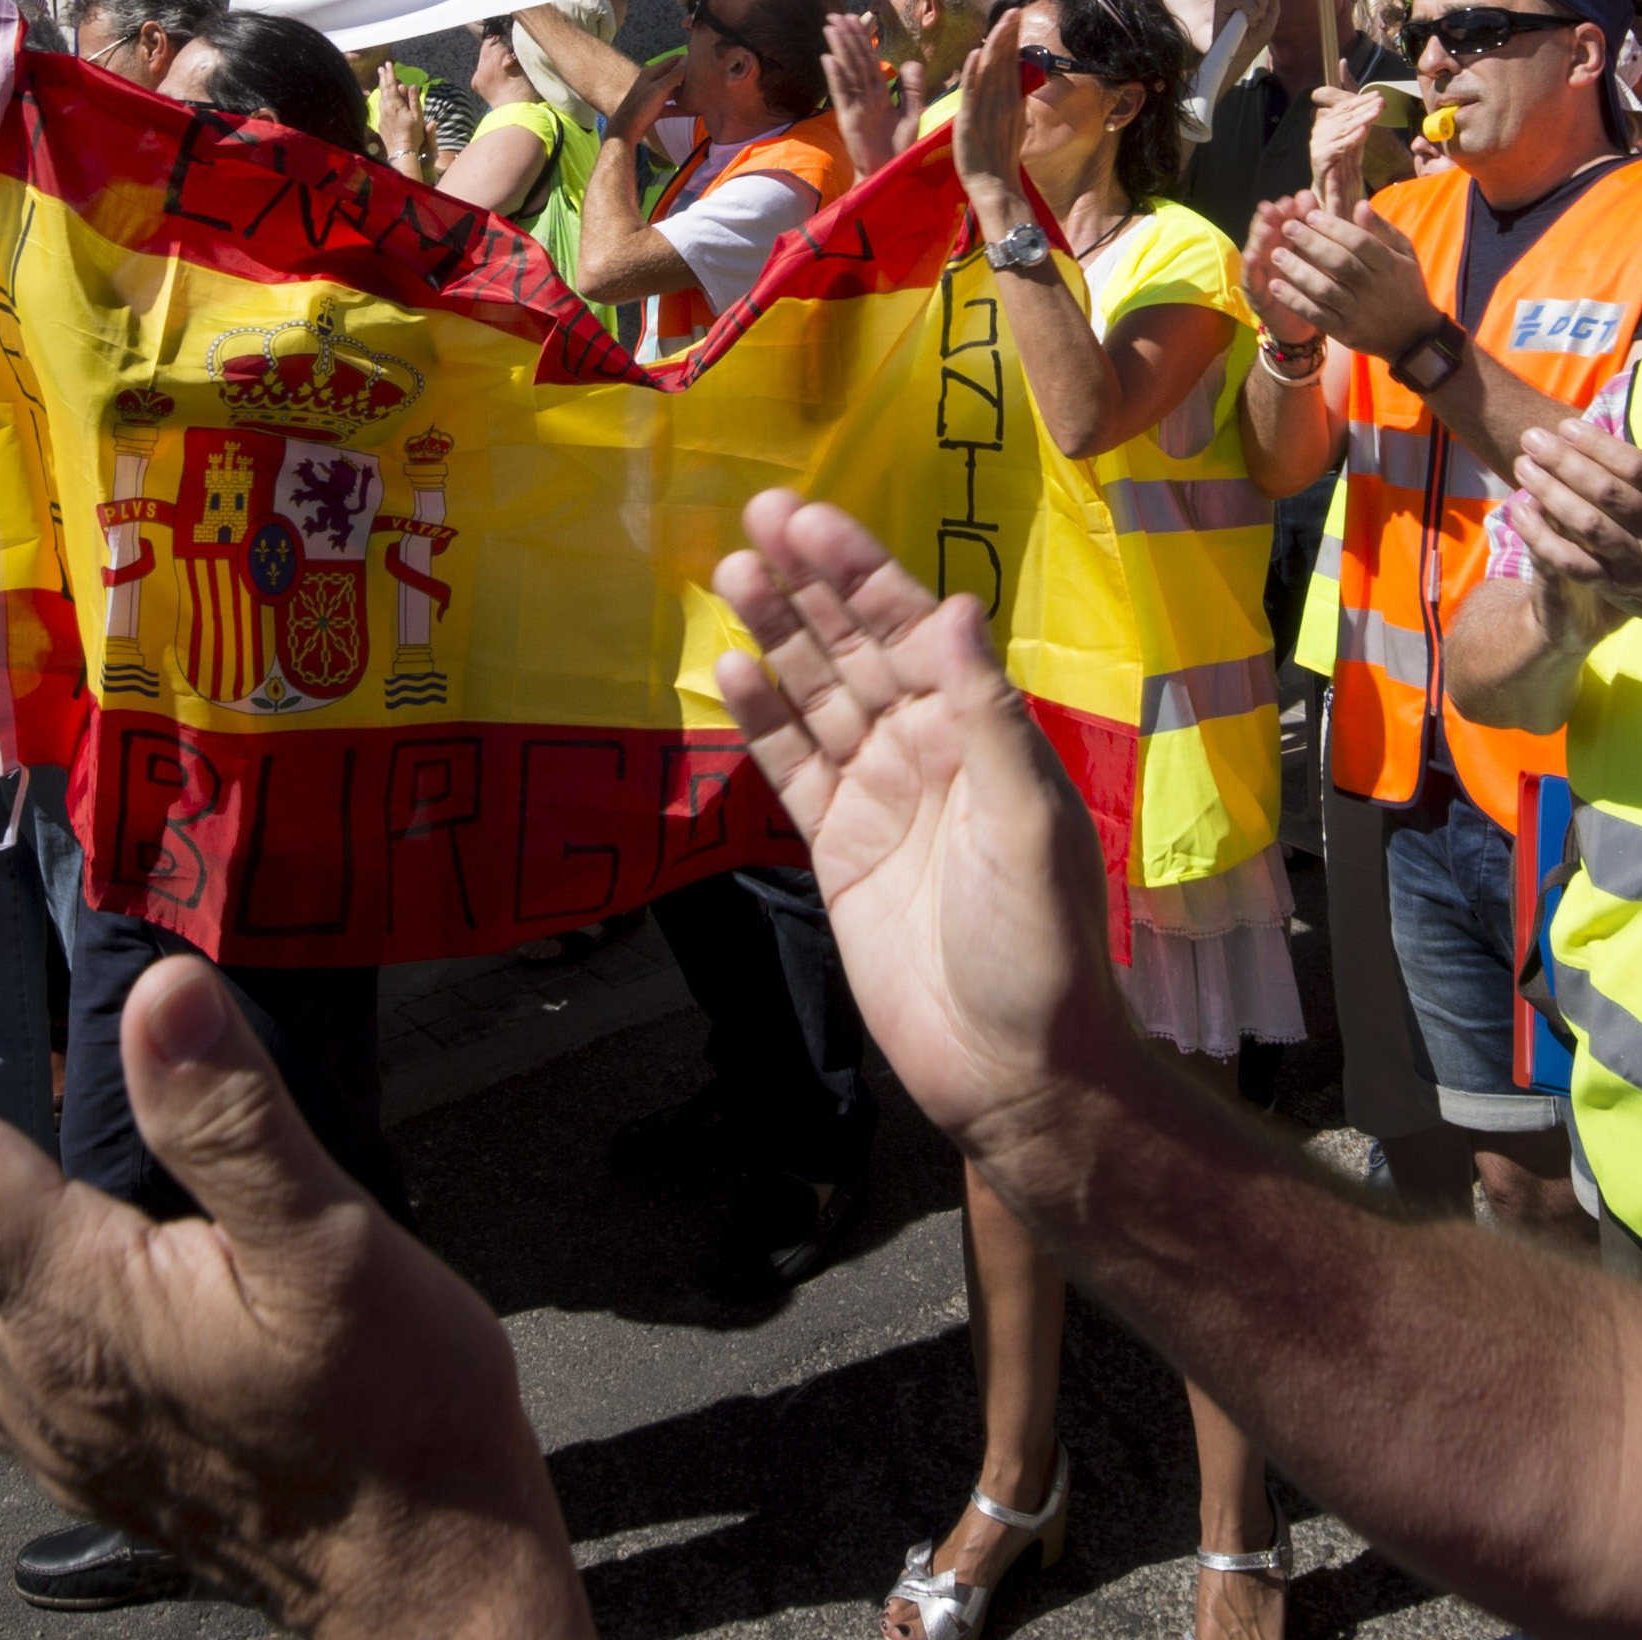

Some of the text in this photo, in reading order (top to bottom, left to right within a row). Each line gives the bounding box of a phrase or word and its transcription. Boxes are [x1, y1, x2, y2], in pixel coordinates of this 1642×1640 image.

[1546, 315, 1619, 344] DGT
[105, 501, 157, 522] PLVS
[390, 516, 457, 542] VLTRA
